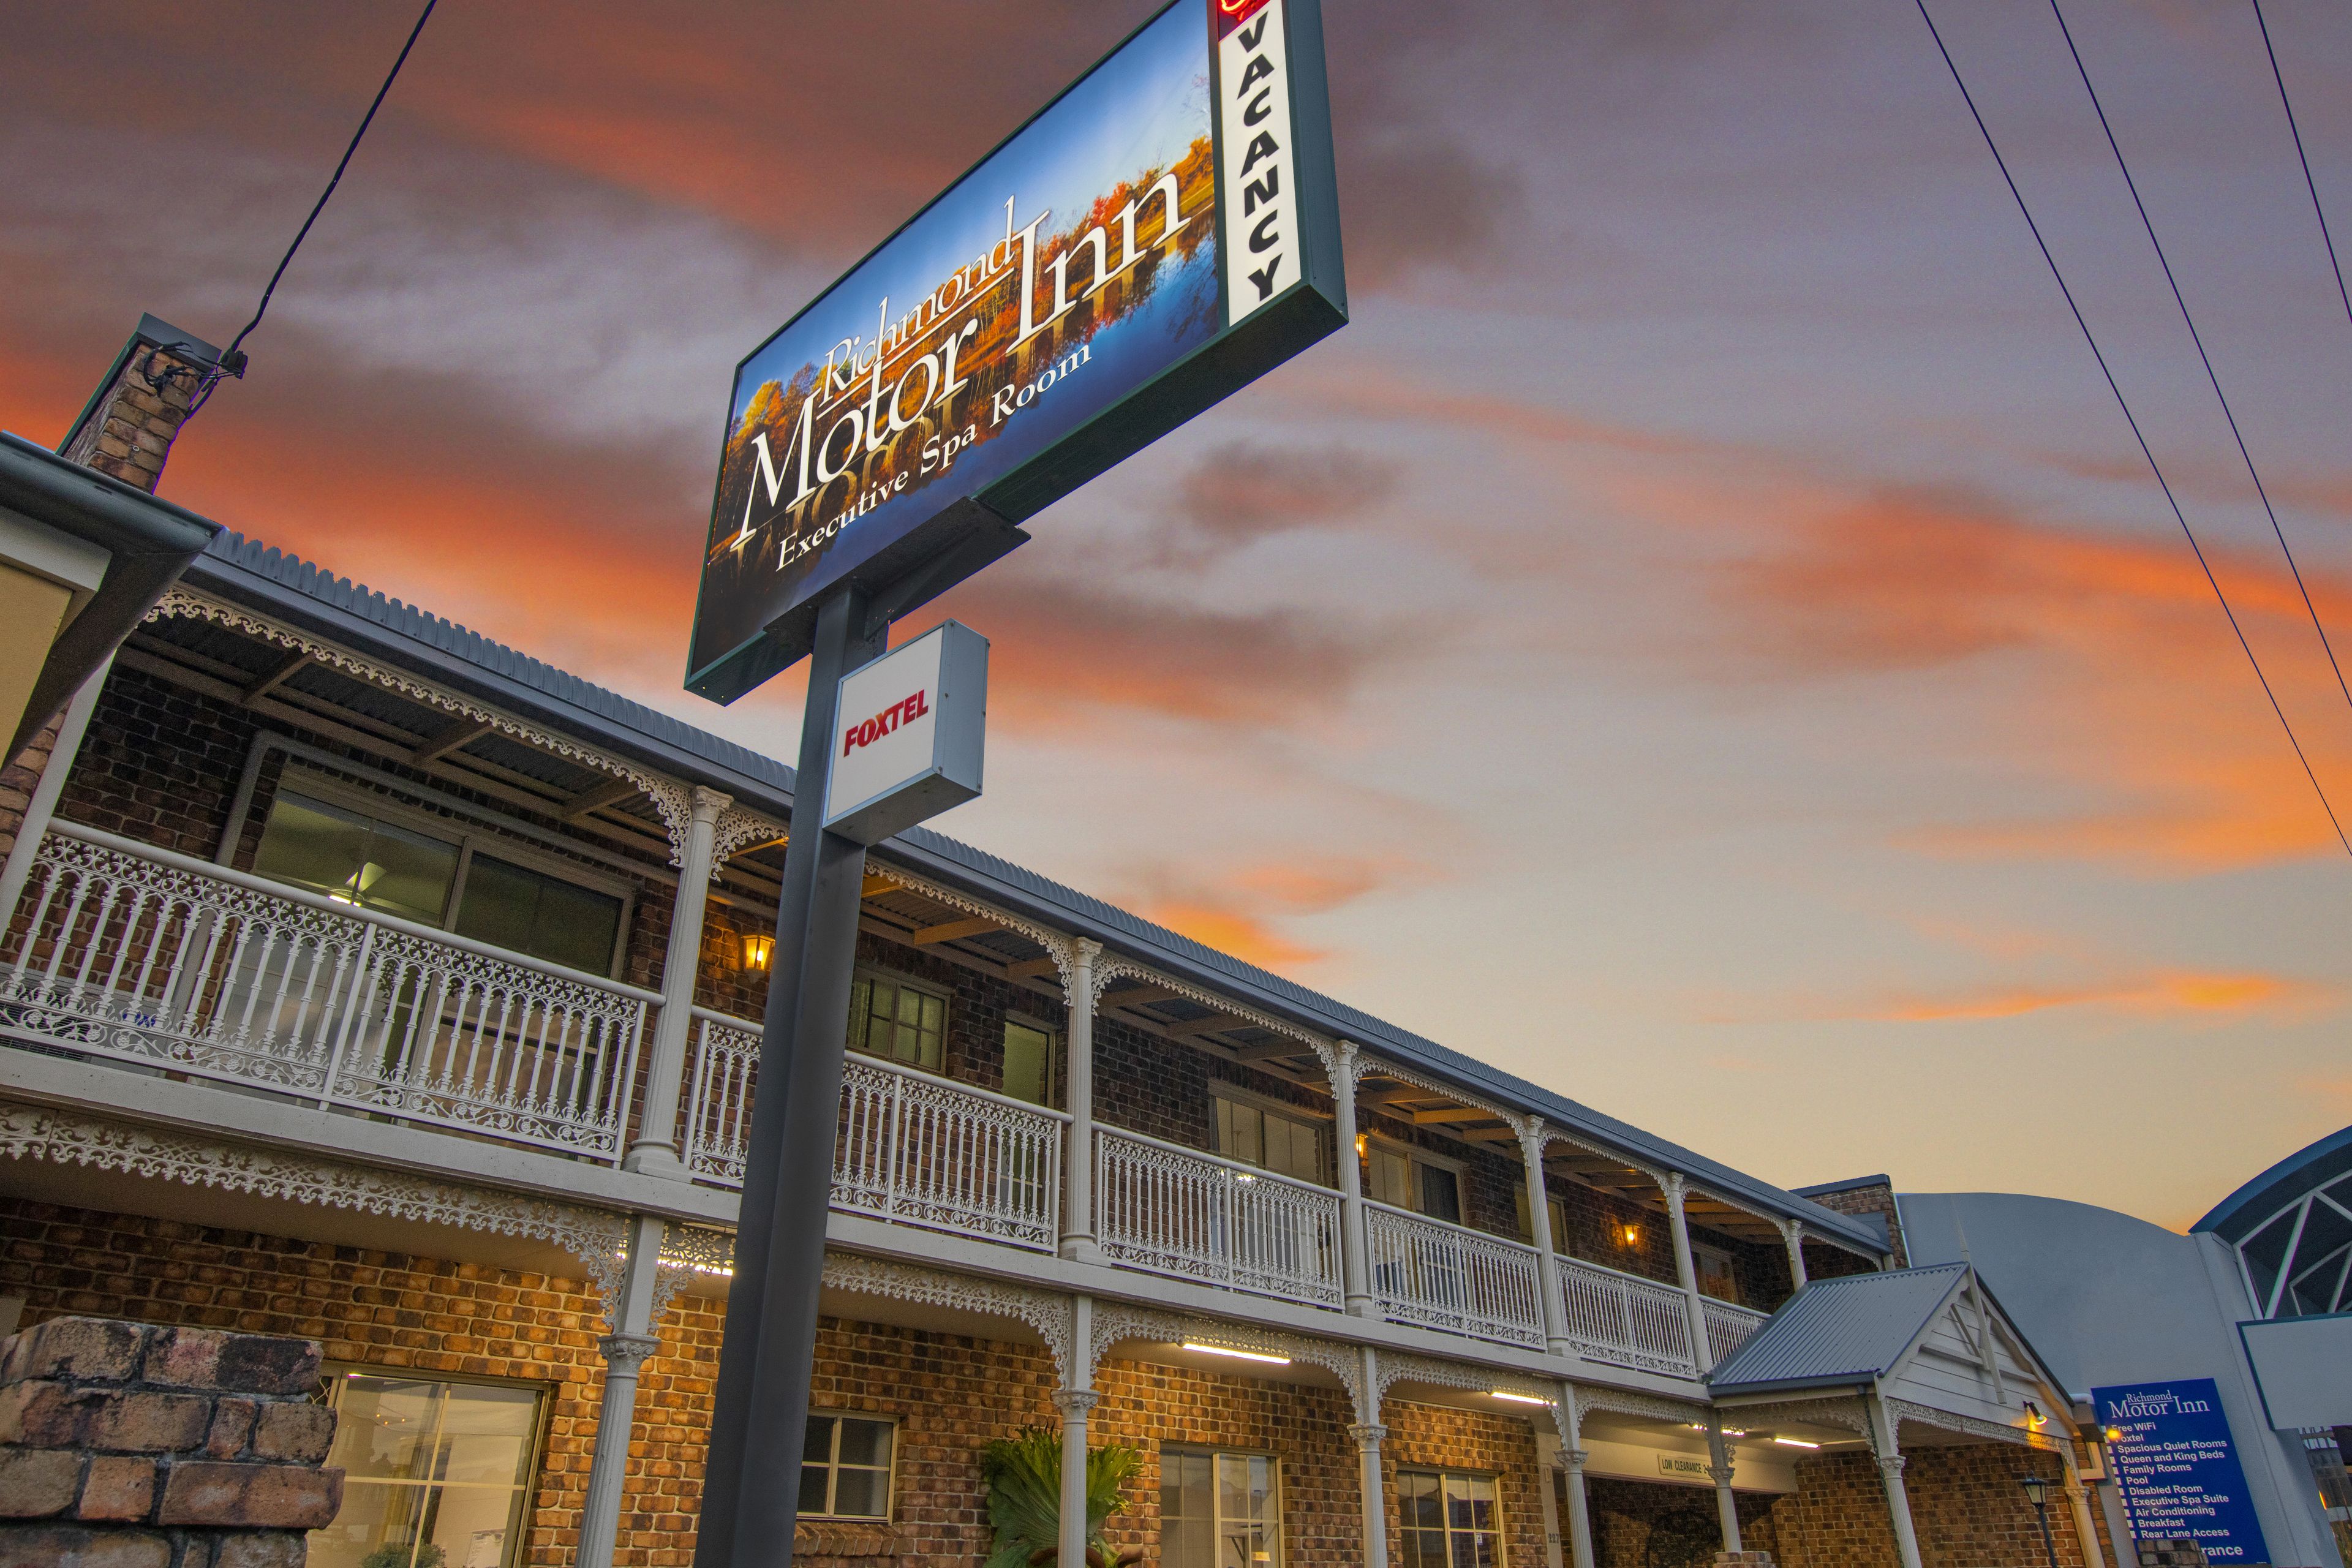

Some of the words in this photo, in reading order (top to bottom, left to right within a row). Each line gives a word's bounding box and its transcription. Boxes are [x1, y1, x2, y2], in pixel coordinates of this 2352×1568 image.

[1237, 10, 1283, 302] VACANCY
[818, 194, 1015, 408] Richmond
[730, 318, 978, 551] Motor
[1006, 173, 1191, 358] Inn
[775, 470, 908, 572] Executive
[920, 423, 978, 477] Spa
[989, 344, 1091, 428] Room
[843, 689, 929, 757] FOXTEL
[2125, 1390, 2173, 1403] Richmond
[2108, 1400, 2168, 1418] Motor
[2173, 1396, 2210, 1414] Inn
[2134, 1422, 2157, 1431] WiFi
[2117, 1444, 2162, 1455] Spacious
[2163, 1441, 2190, 1451] Quiet
[2192, 1440, 2227, 1449] Rooms
[2120, 1455, 2152, 1464] Queen
[2154, 1453, 2172, 1462] and
[2174, 1452, 2197, 1461] King
[2198, 1450, 2225, 1459] Beds
[1662, 1459, 1673, 1470] LOW
[1675, 1460, 1702, 1473] CLEARANCE
[2123, 1465, 2155, 1475] Family
[2157, 1464, 2192, 1472] Rooms
[2126, 1476, 2149, 1485] Pool
[2129, 1486, 2171, 1495] Disabled
[2132, 1496, 2179, 1506] Executive
[2181, 1495, 2201, 1504] Spa
[2203, 1494, 2230, 1503] Suite
[2152, 1506, 2215, 1517] Conditioning
[2138, 1518, 2185, 1528] Breakfast
[1548, 1533, 1559, 1544] 227
[2141, 1530, 2164, 1539] Rear
[2166, 1529, 2191, 1537] Lane
[2201, 1546, 2243, 1556] rance
